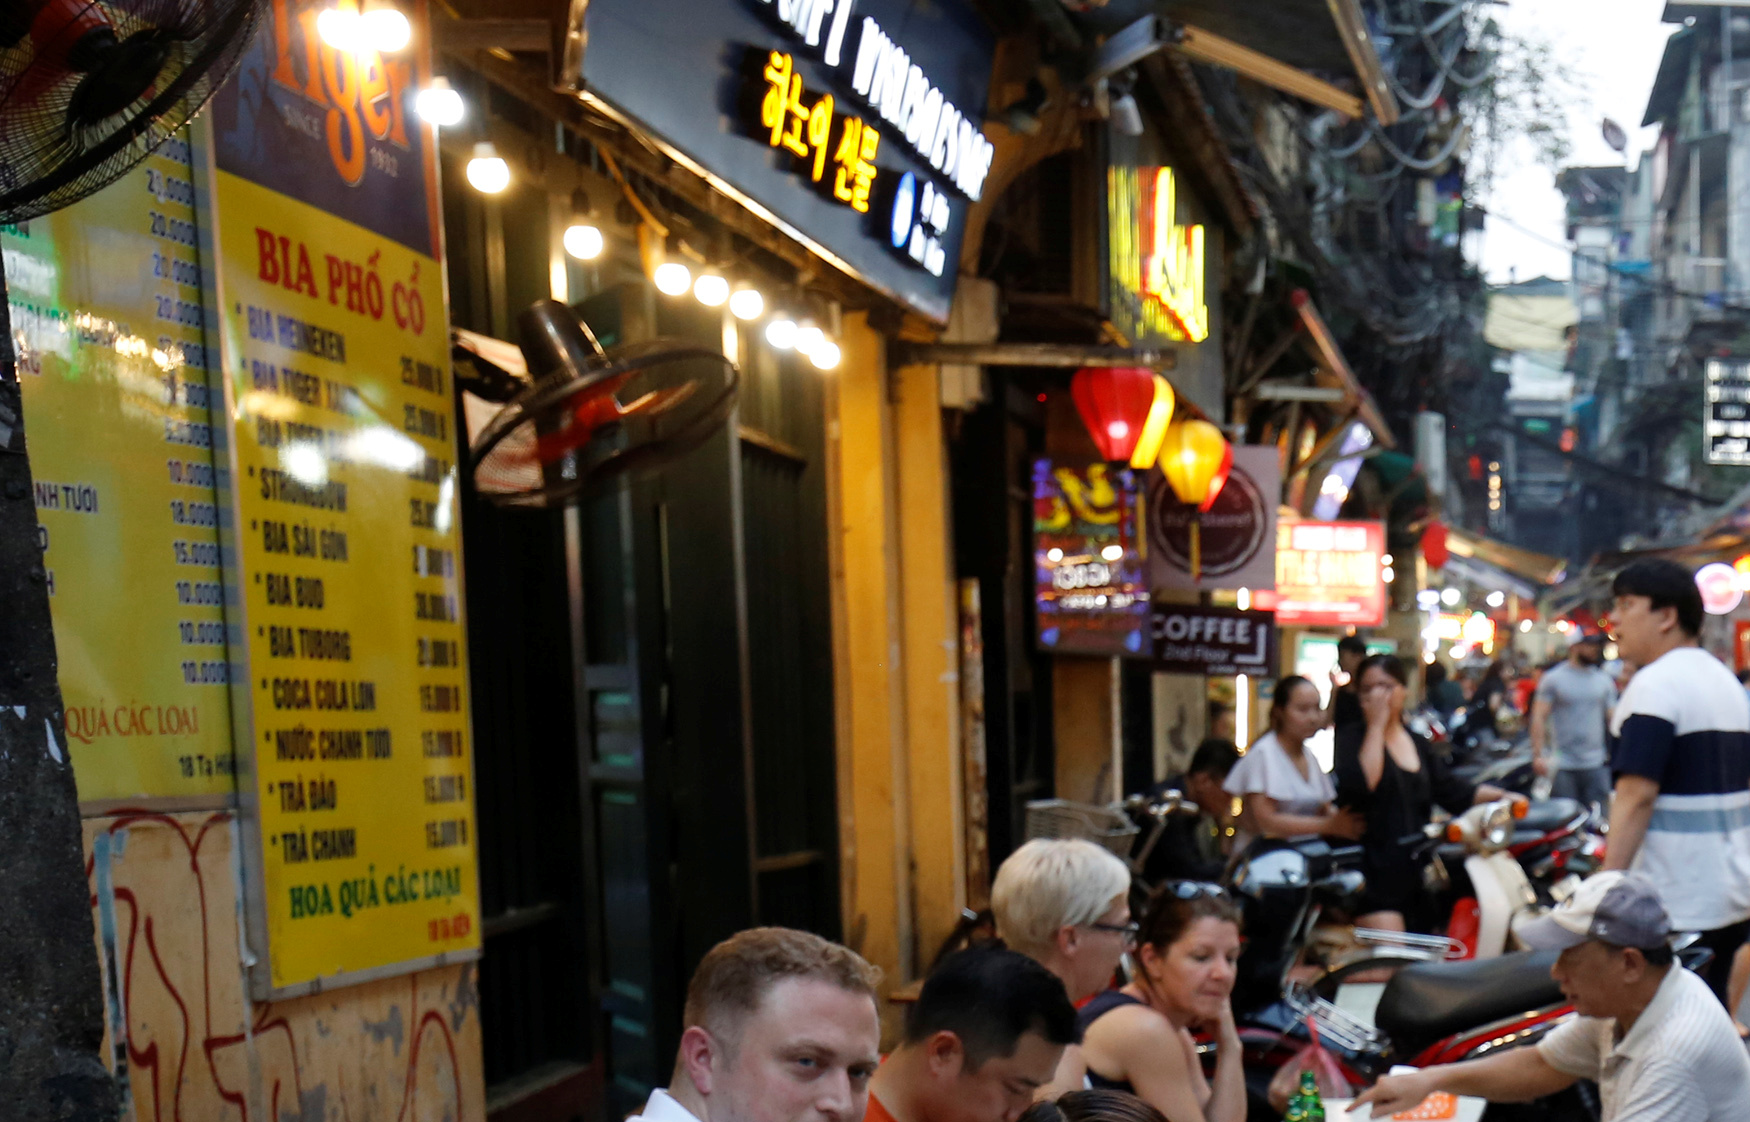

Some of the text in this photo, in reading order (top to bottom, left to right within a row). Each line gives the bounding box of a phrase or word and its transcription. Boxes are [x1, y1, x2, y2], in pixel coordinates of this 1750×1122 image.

[255, 226, 426, 336] BIA PHỐ CỔ
[1152, 614, 1251, 644] COFFEE
[113, 699, 153, 737] CÁC
[289, 884, 334, 919] HOA
[339, 863, 379, 918] QUẢ
